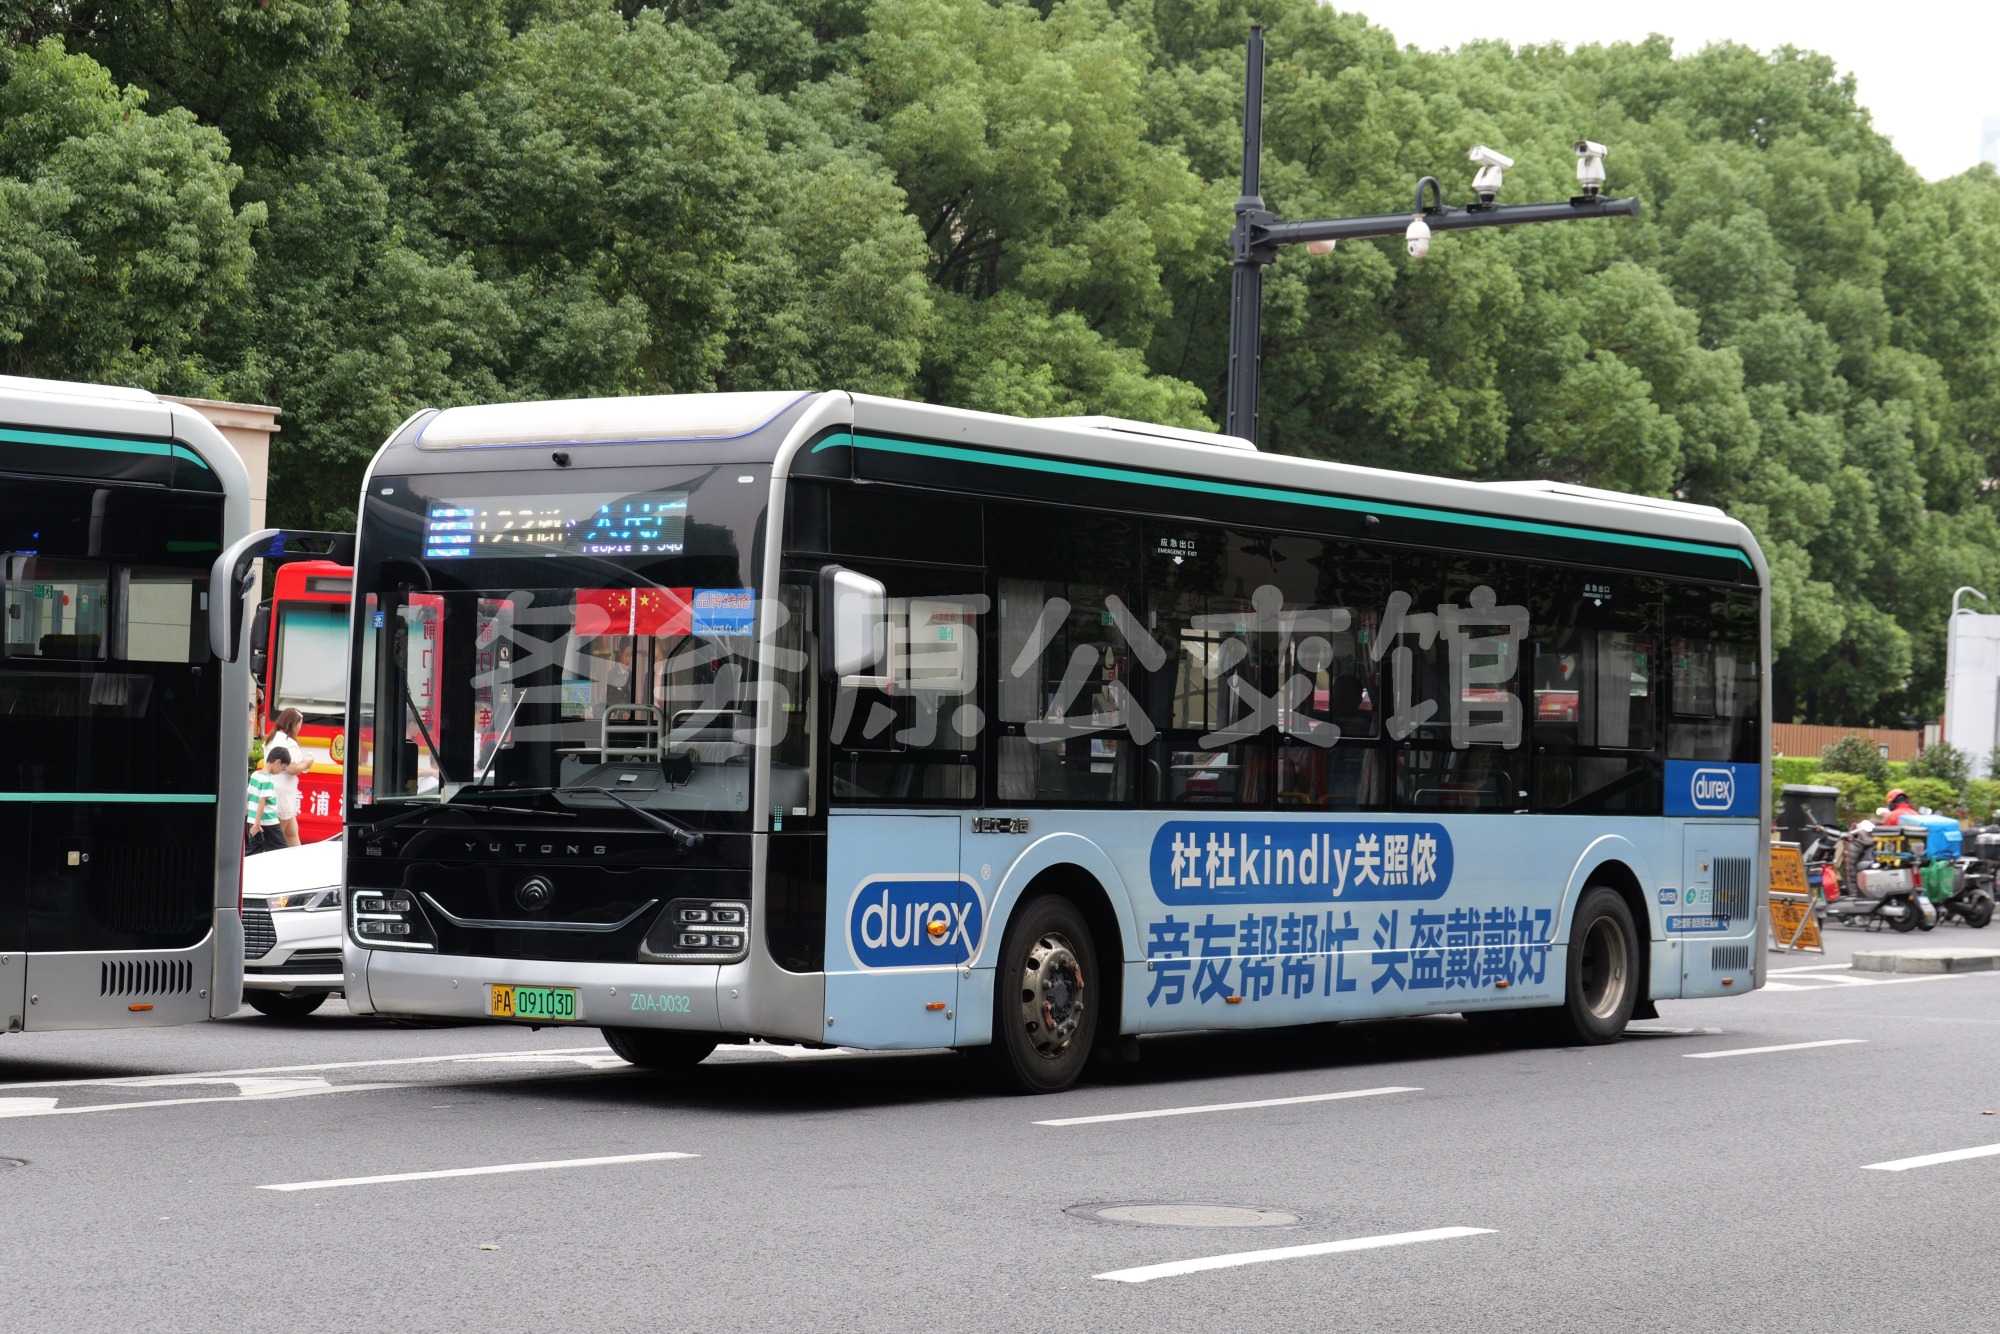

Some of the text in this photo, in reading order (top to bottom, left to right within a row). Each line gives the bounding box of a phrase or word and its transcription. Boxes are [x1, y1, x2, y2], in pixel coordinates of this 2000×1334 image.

[1157, 547, 1186, 556] EMERGENCY
[1160, 537, 1195, 549] 应急出口
[696, 593, 751, 609] 品牌线路
[1695, 774, 1731, 805] durex
[464, 842, 606, 855] YUTONG
[1170, 831, 1437, 897] 杜杜kindly关照侬
[861, 888, 976, 956] durex
[1146, 905, 1553, 1008] 旁友帮帮忙 头盔戴戴好
[518, 990, 574, 1016] 09103D
[630, 993, 691, 1013] Z0A-0032
